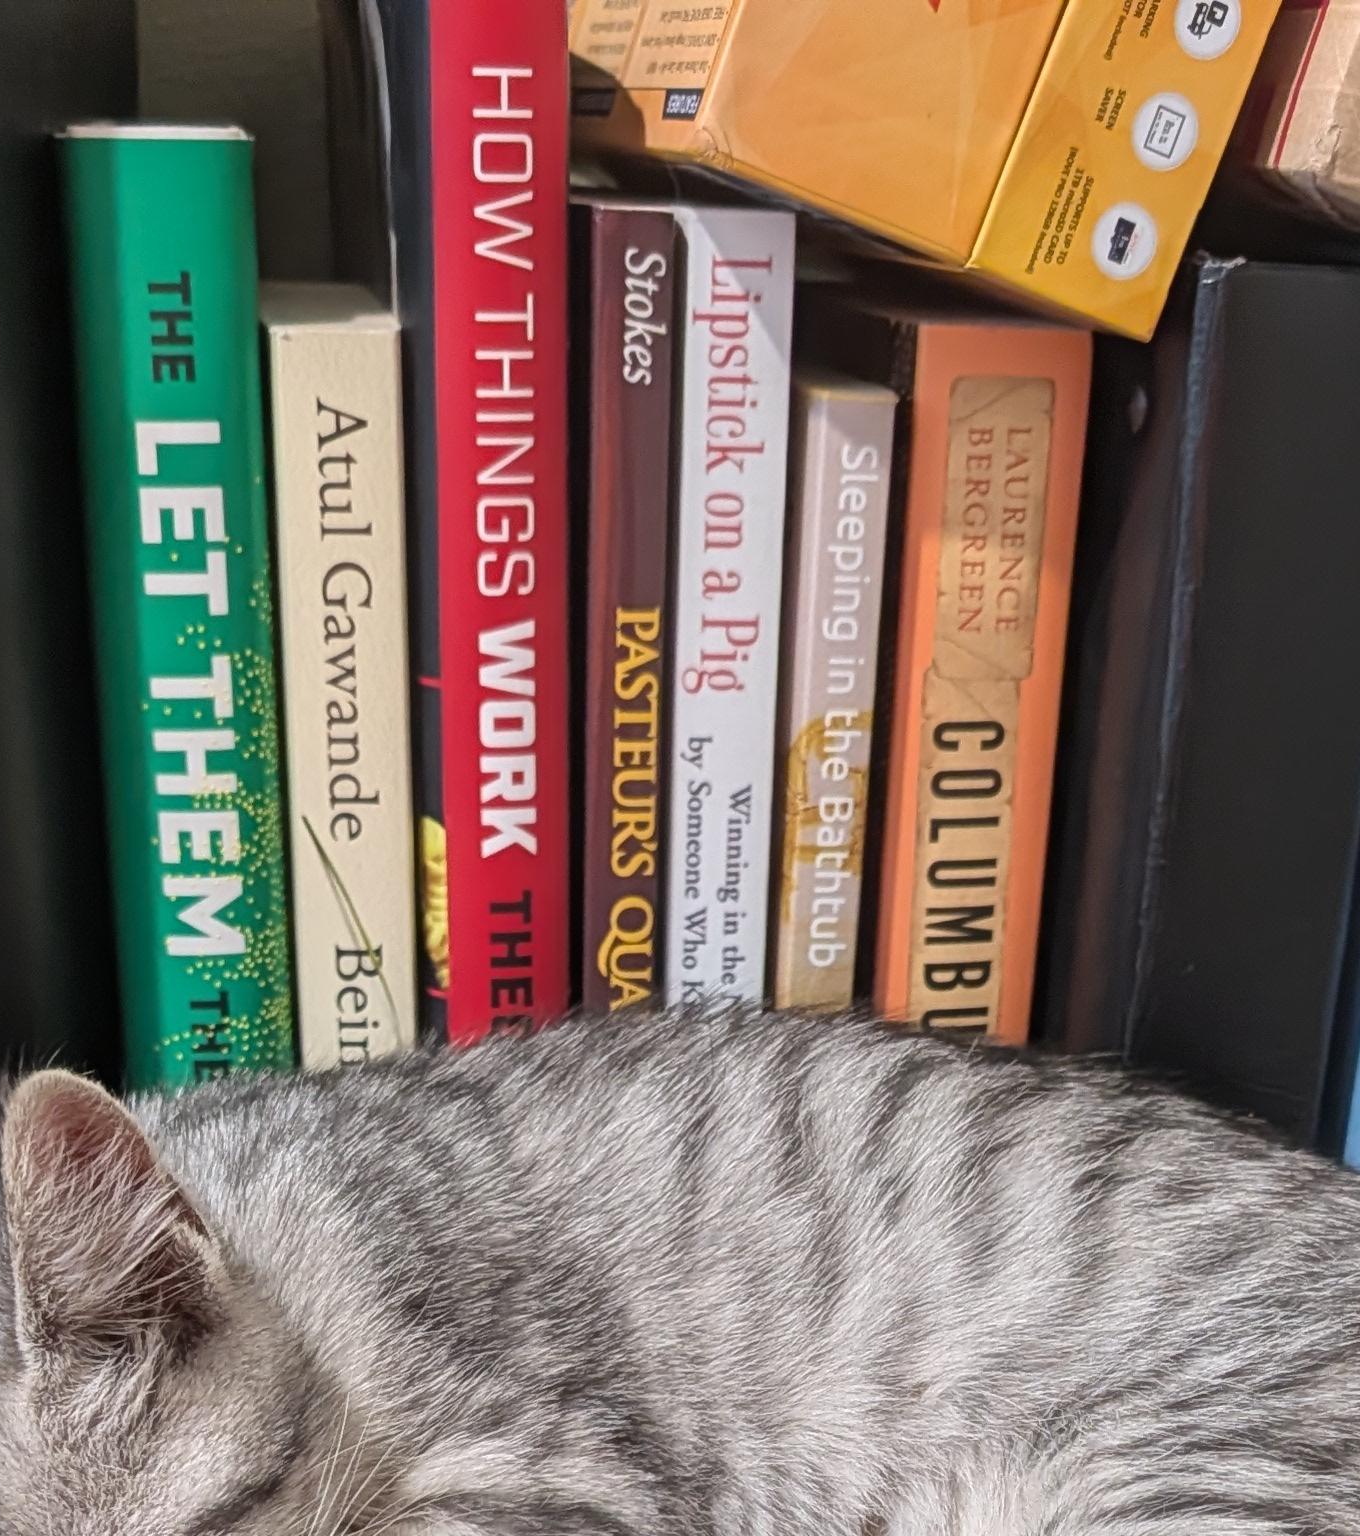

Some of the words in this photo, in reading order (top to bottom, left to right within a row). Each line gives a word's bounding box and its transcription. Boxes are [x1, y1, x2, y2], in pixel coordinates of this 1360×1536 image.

[1095, 87, 1114, 122] SAVER
[1105, 89, 1127, 131] SCREEN
[472, 66, 535, 270] HOW
[1068, 176, 1094, 232] SUPPORTS
[1044, 235, 1059, 264] CARD
[1056, 251, 1068, 265] TO
[1064, 233, 1073, 249] UP
[146, 271, 196, 384] THE
[623, 247, 667, 386] Stokes
[693, 254, 772, 473] Lipstick
[315, 398, 372, 541] Atul
[475, 302, 537, 598] THINGS
[135, 420, 230, 617] LET
[703, 493, 746, 551] on
[824, 444, 879, 641] Sleeping
[957, 427, 992, 634] BERGREEN
[995, 426, 1034, 634] LAURENCE
[701, 568, 741, 600] a
[322, 563, 381, 842] Gawande
[681, 613, 761, 696] Pig
[827, 648, 865, 695] in
[477, 621, 538, 859] WORK
[611, 606, 661, 877] PASTEUR'S
[680, 736, 713, 769] by
[821, 707, 864, 781] the
[149, 655, 246, 957] THEM
[684, 780, 712, 899] Someone
[716, 784, 752, 903] Winning
[681, 906, 708, 970] Who
[723, 911, 747, 935] in
[808, 797, 855, 969] Bathtub
[721, 946, 746, 985] the
